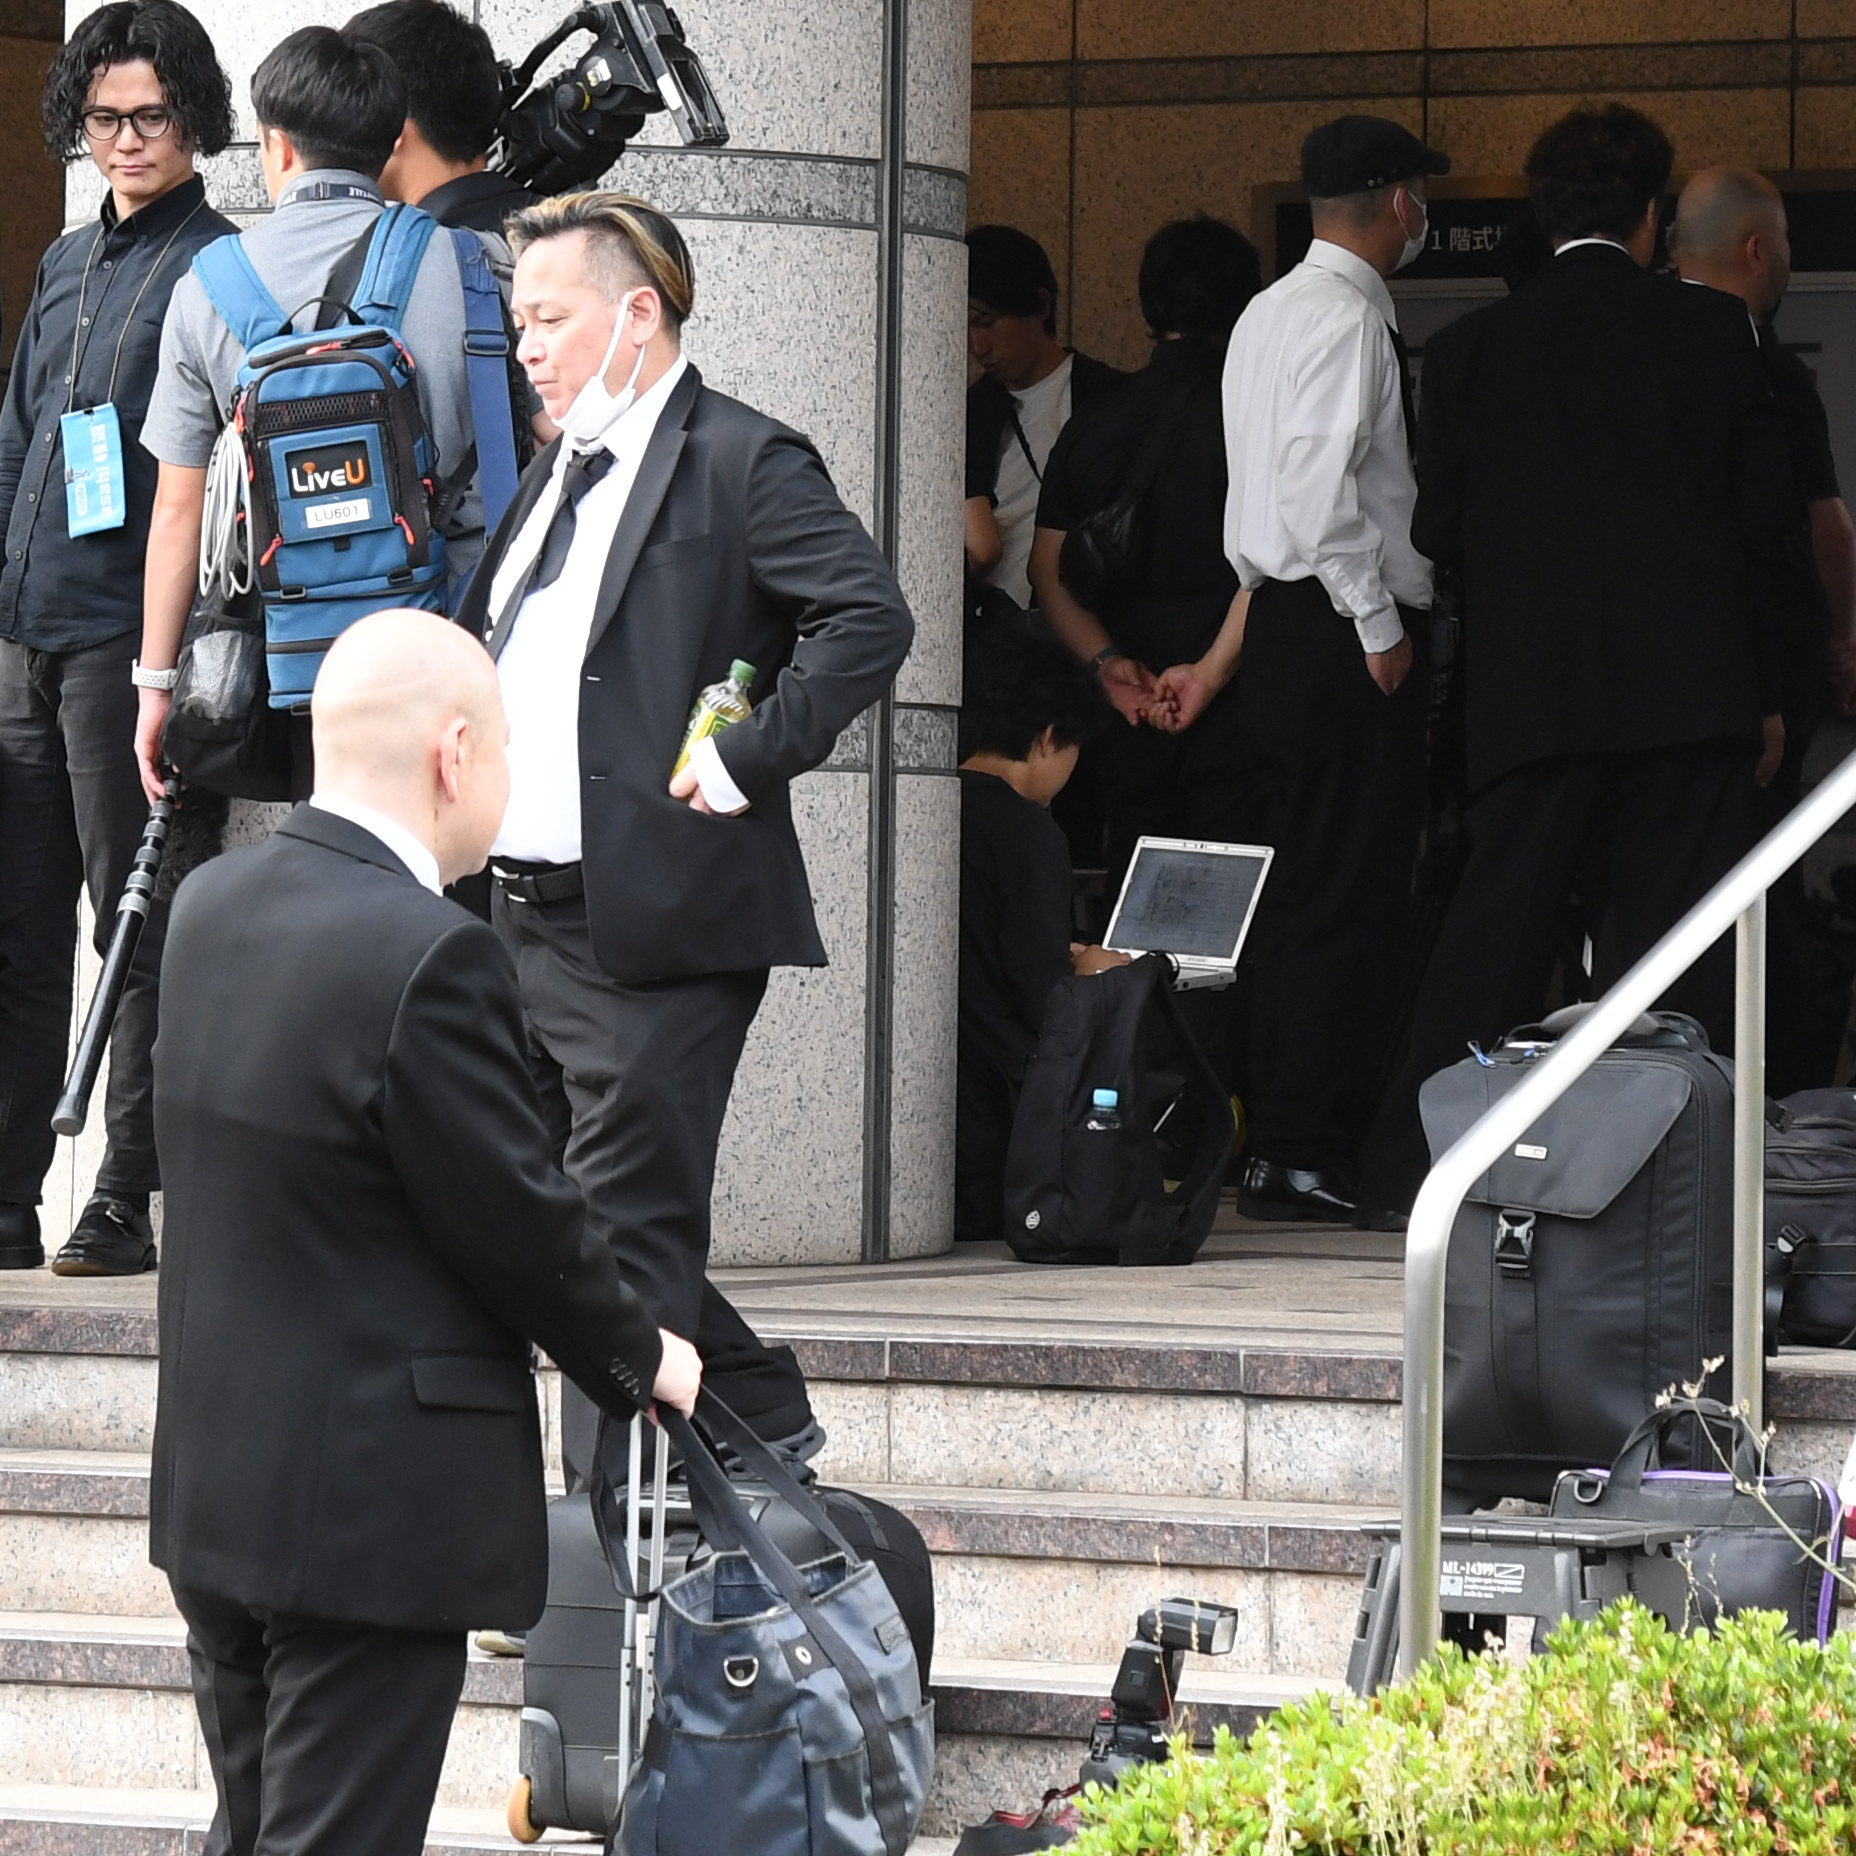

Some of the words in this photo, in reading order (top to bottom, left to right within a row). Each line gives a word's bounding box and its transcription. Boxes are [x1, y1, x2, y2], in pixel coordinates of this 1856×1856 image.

[1431, 226, 1506, 252] 1階式
[291, 458, 365, 492] LiveU
[314, 505, 358, 522] LU601
